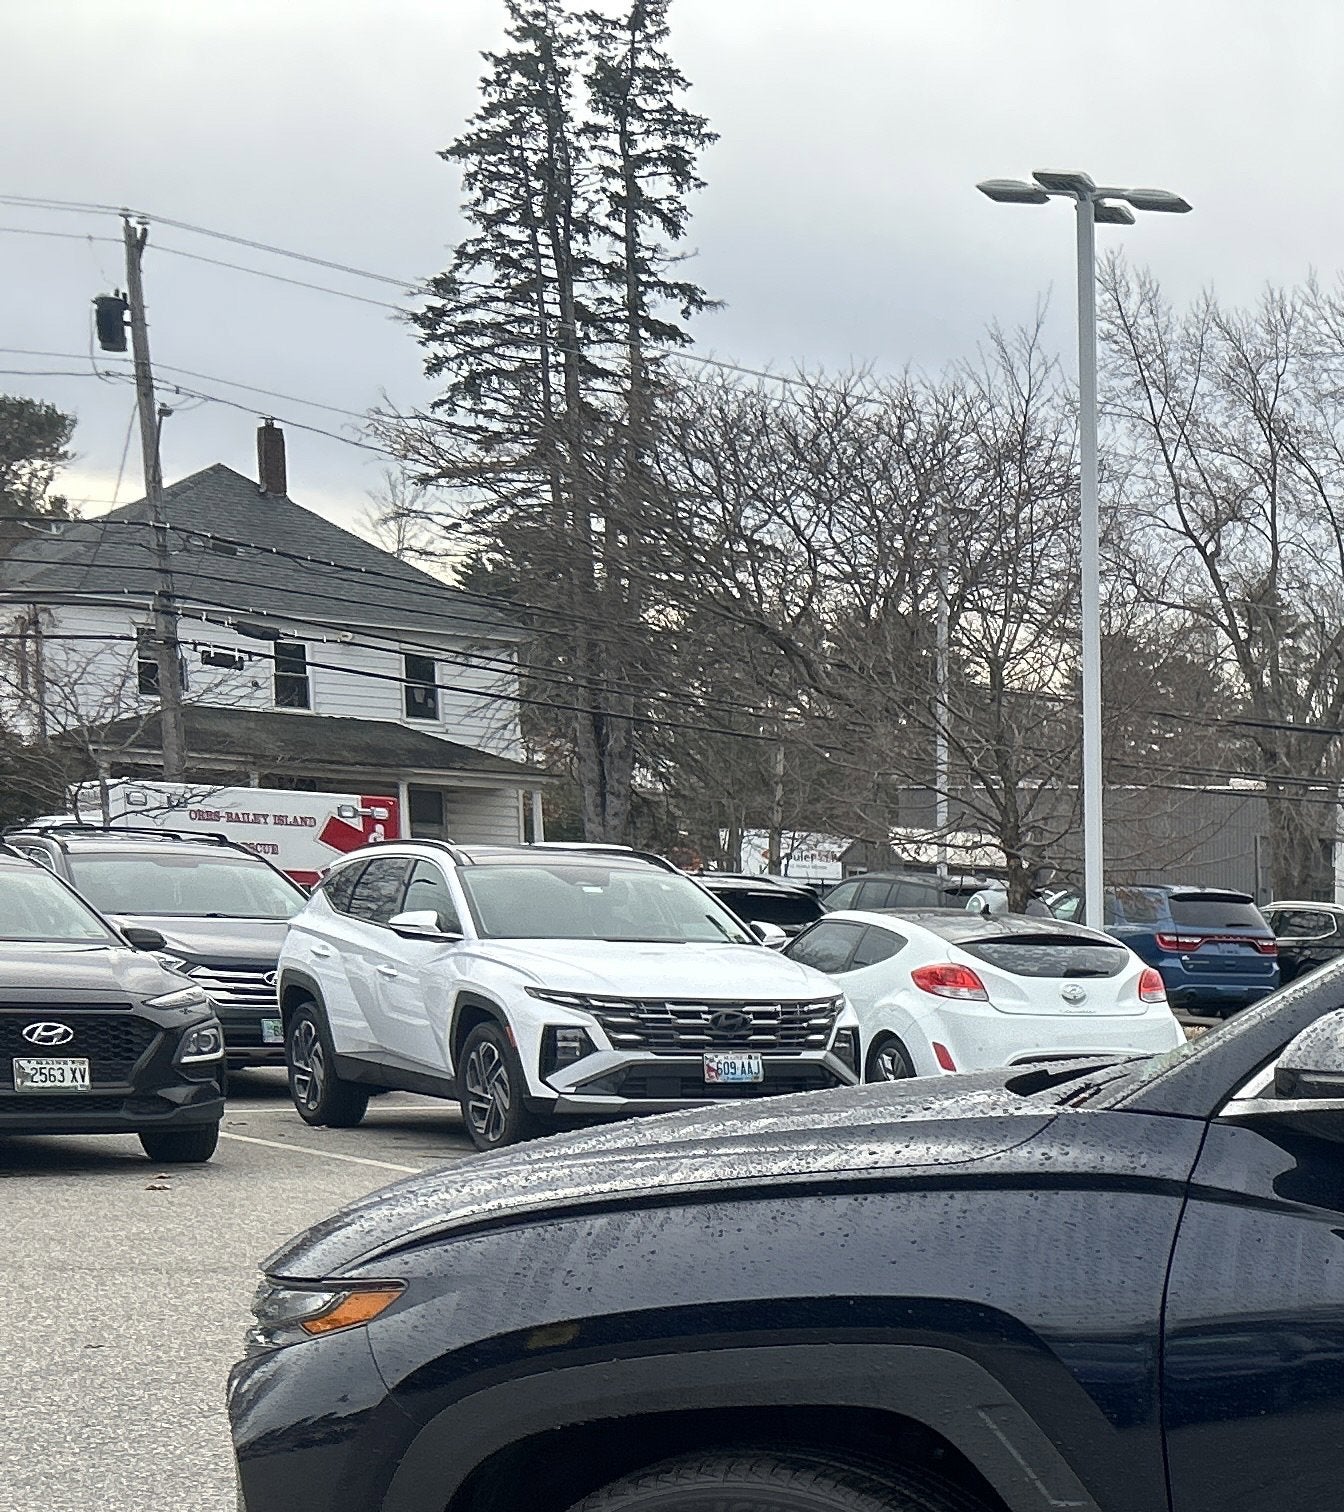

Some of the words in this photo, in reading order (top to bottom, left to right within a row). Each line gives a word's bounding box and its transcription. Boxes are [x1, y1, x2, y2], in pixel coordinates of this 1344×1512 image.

[272, 814, 317, 828] ISLAND
[30, 1066, 65, 1084] 2563
[69, 1066, 87, 1084] XV
[716, 1061, 737, 1076] 609
[740, 1061, 761, 1076] AAJ
